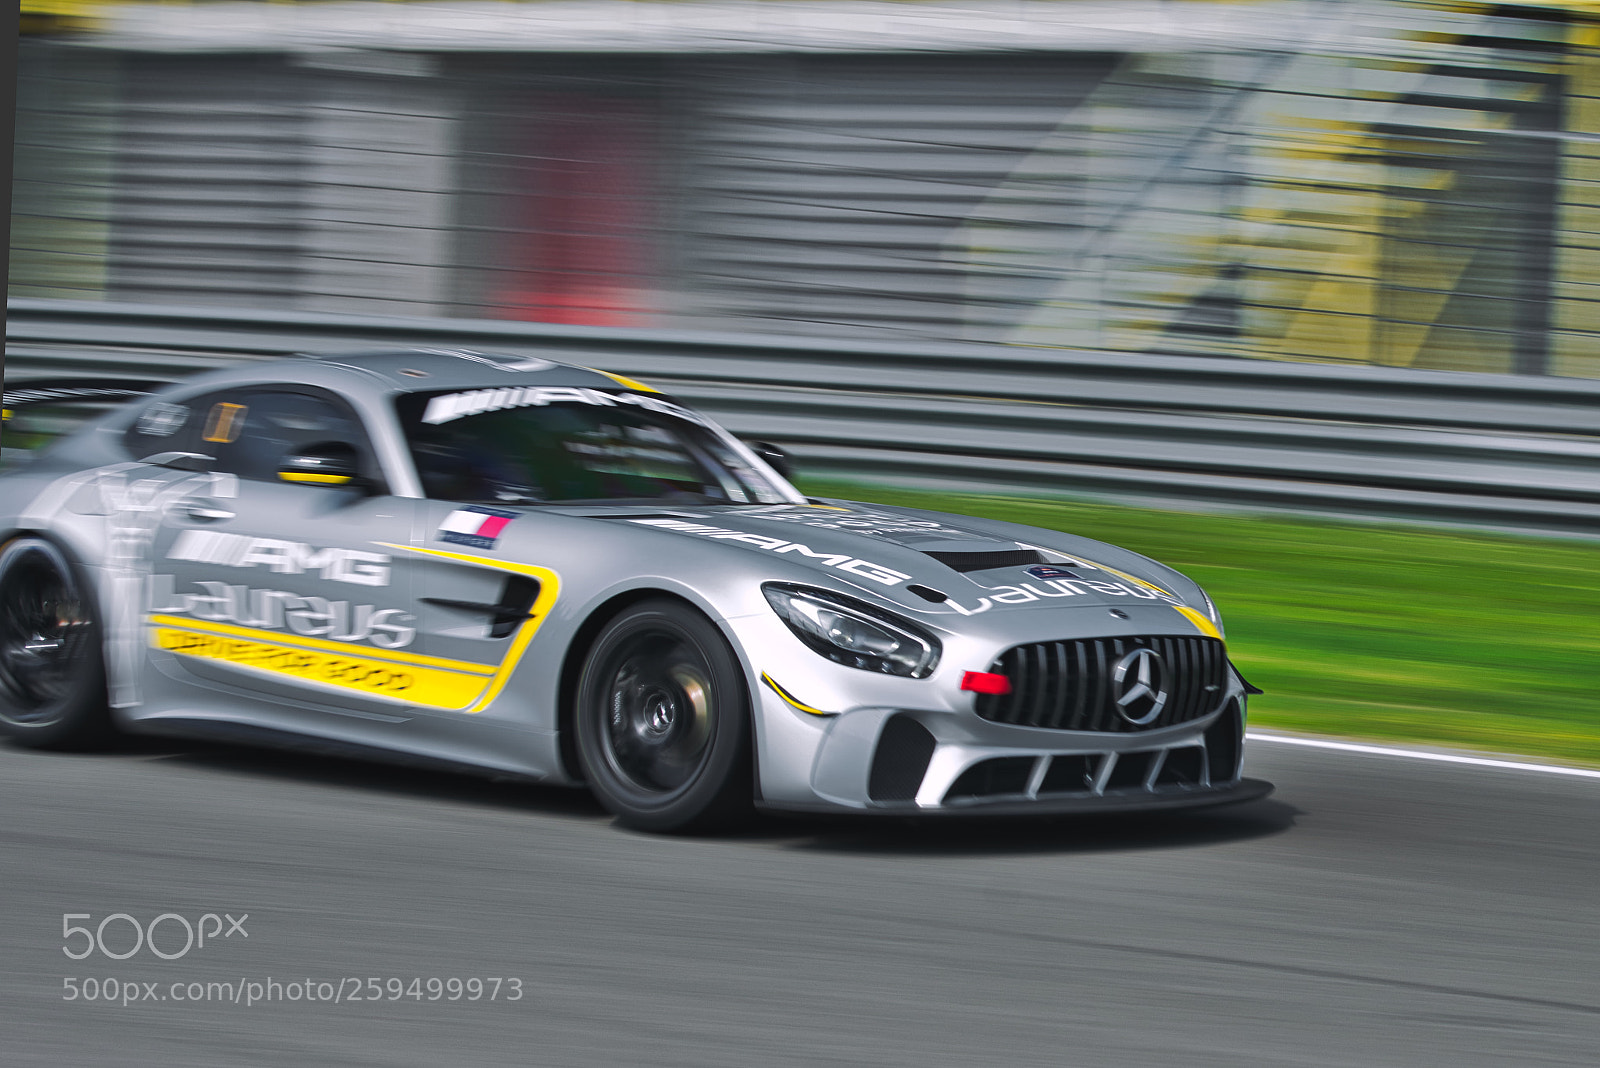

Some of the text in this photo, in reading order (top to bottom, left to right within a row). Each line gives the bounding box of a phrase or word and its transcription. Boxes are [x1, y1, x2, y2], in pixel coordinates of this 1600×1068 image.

[240, 536, 392, 587] AMG
[712, 532, 912, 586] AMG
[147, 574, 417, 649] Laureus
[945, 578, 1188, 617] Laureus
